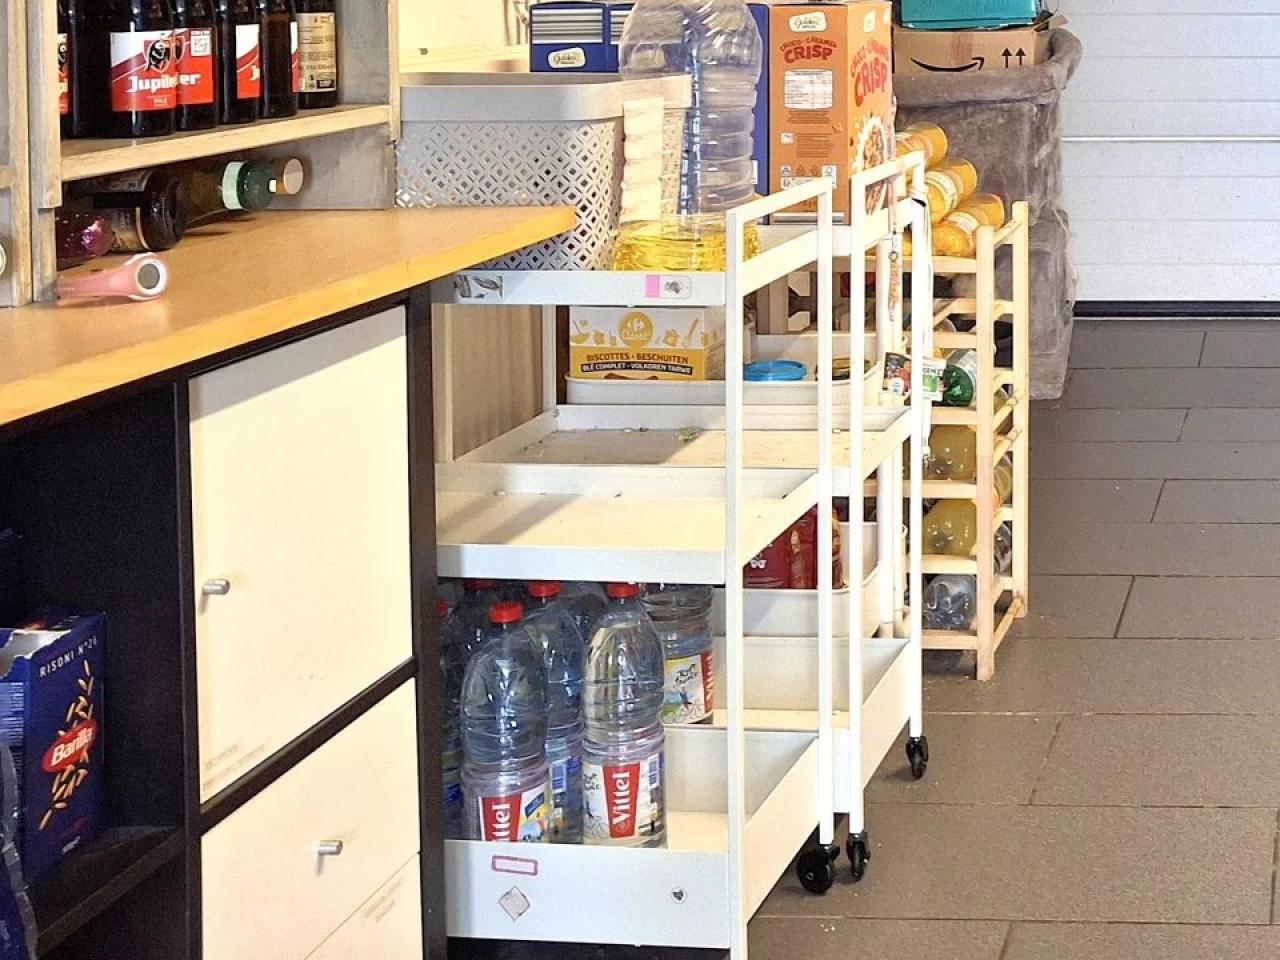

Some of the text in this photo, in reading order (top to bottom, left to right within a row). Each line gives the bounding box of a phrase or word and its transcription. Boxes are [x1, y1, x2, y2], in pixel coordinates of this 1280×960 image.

[784, 44, 833, 64] CRISP
[855, 57, 887, 107] CRISP
[586, 352, 689, 364] BISCOTTES BESCHUITEN
[39, 651, 75, 678] RISONI
[51, 728, 94, 766] Barilla
[611, 769, 632, 826] Vittel
